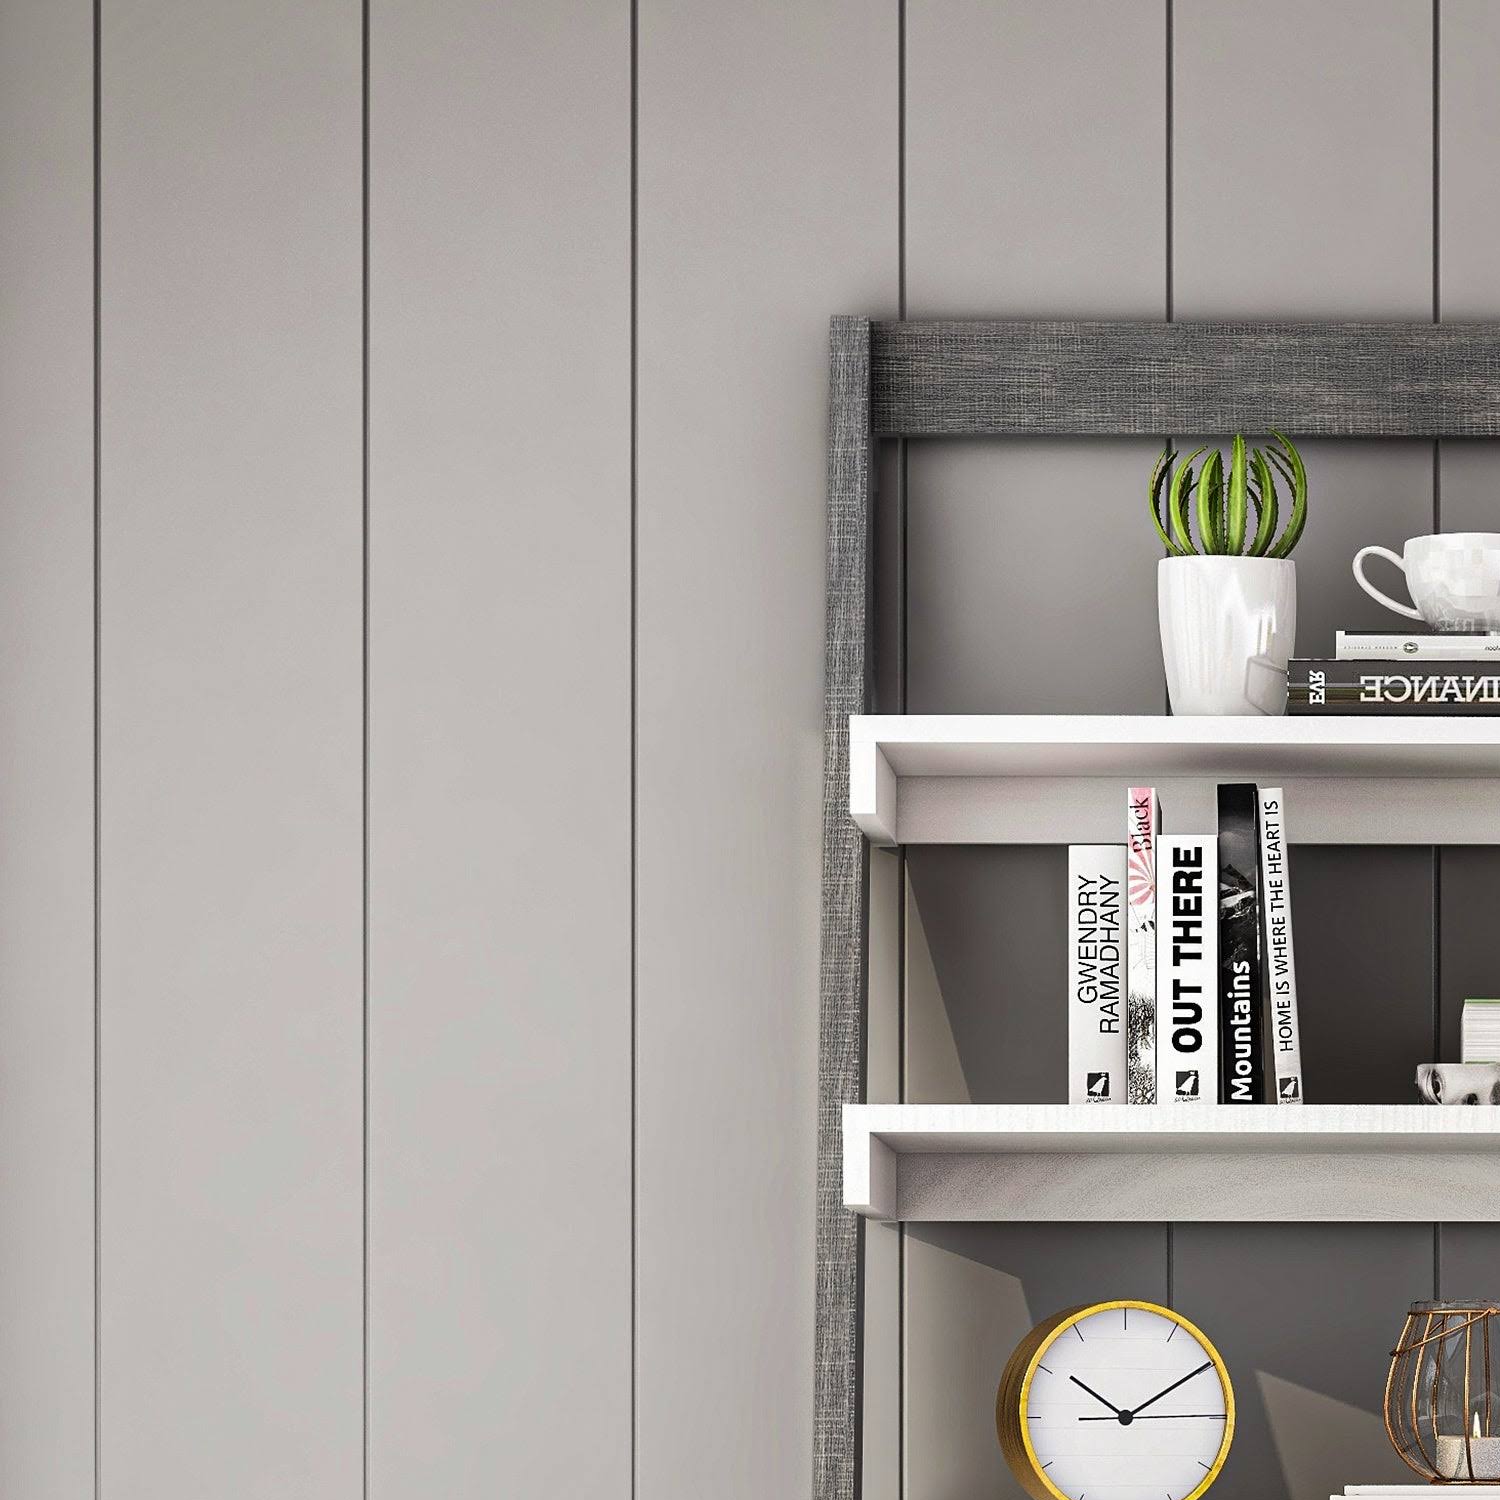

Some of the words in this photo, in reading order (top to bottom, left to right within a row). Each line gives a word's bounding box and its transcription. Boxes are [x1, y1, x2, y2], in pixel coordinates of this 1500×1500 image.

[1129, 797, 1152, 853] Black
[1263, 800, 1279, 815] IS
[1265, 820, 1283, 874] HEART
[1172, 846, 1203, 967] THERE
[1268, 879, 1285, 913] THE
[1077, 875, 1098, 1004] GWENDRY
[1099, 874, 1120, 1034] RAMADHANY
[1272, 916, 1289, 976] WHERE
[1171, 979, 1203, 1053] OUT
[1275, 980, 1290, 995] IS
[1227, 960, 1253, 1100] Mountains
[1277, 1000, 1294, 1052] HOME
